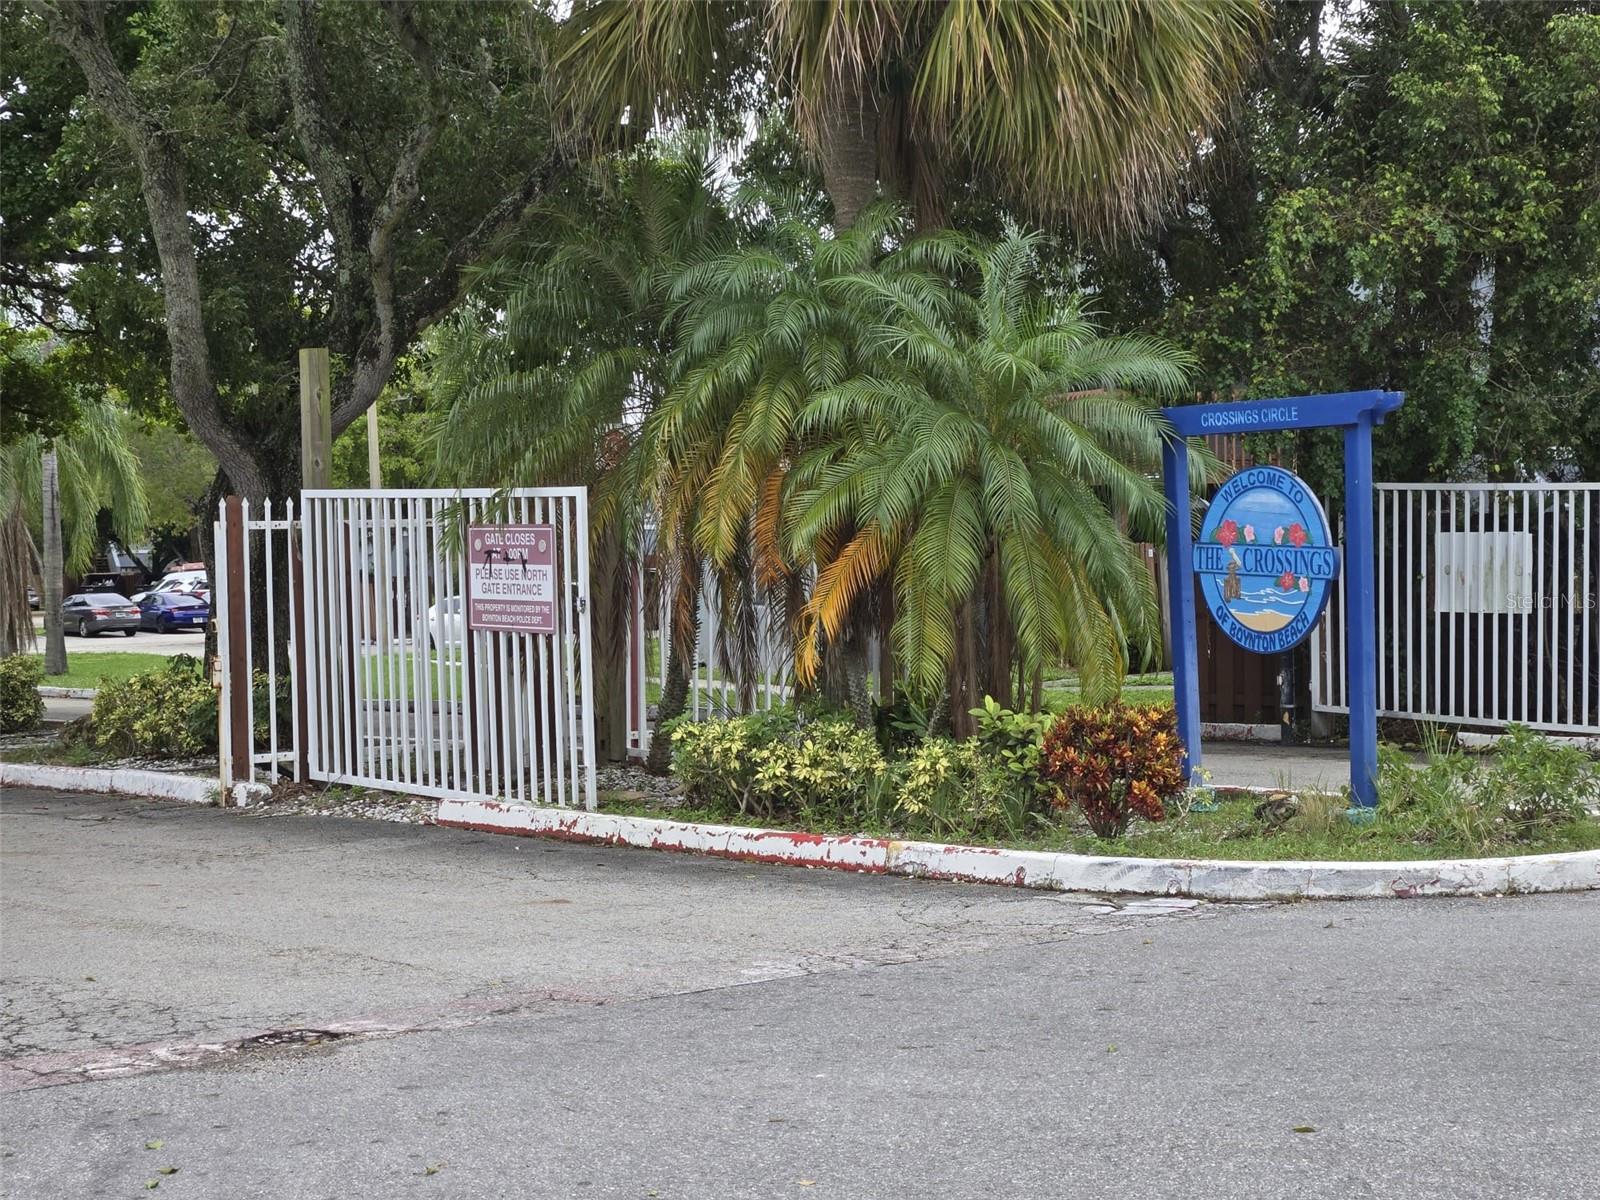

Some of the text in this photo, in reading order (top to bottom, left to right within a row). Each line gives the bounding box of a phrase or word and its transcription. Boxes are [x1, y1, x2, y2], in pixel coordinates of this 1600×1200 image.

[1201, 407, 1299, 428] CROSSINGS CIRCLE
[1220, 470, 1304, 504] WELCOME TO
[485, 532, 535, 546] GATE CLOSES
[1196, 545, 1332, 577] THE CROSSINGS
[475, 568, 548, 582] PLEASE USE NORTH
[481, 582, 542, 596] GATE ENTRANCE
[485, 603, 506, 612] PROPERTY
[506, 604, 511, 612] IS
[511, 604, 535, 613] MONITORED
[535, 605, 541, 614] BY
[541, 605, 550, 614] THE
[481, 613, 501, 622] BOYNTON
[501, 614, 516, 623] BEACH
[516, 615, 531, 624] POLICE
[1216, 605, 1310, 651] OF BOYNTON BEACH
